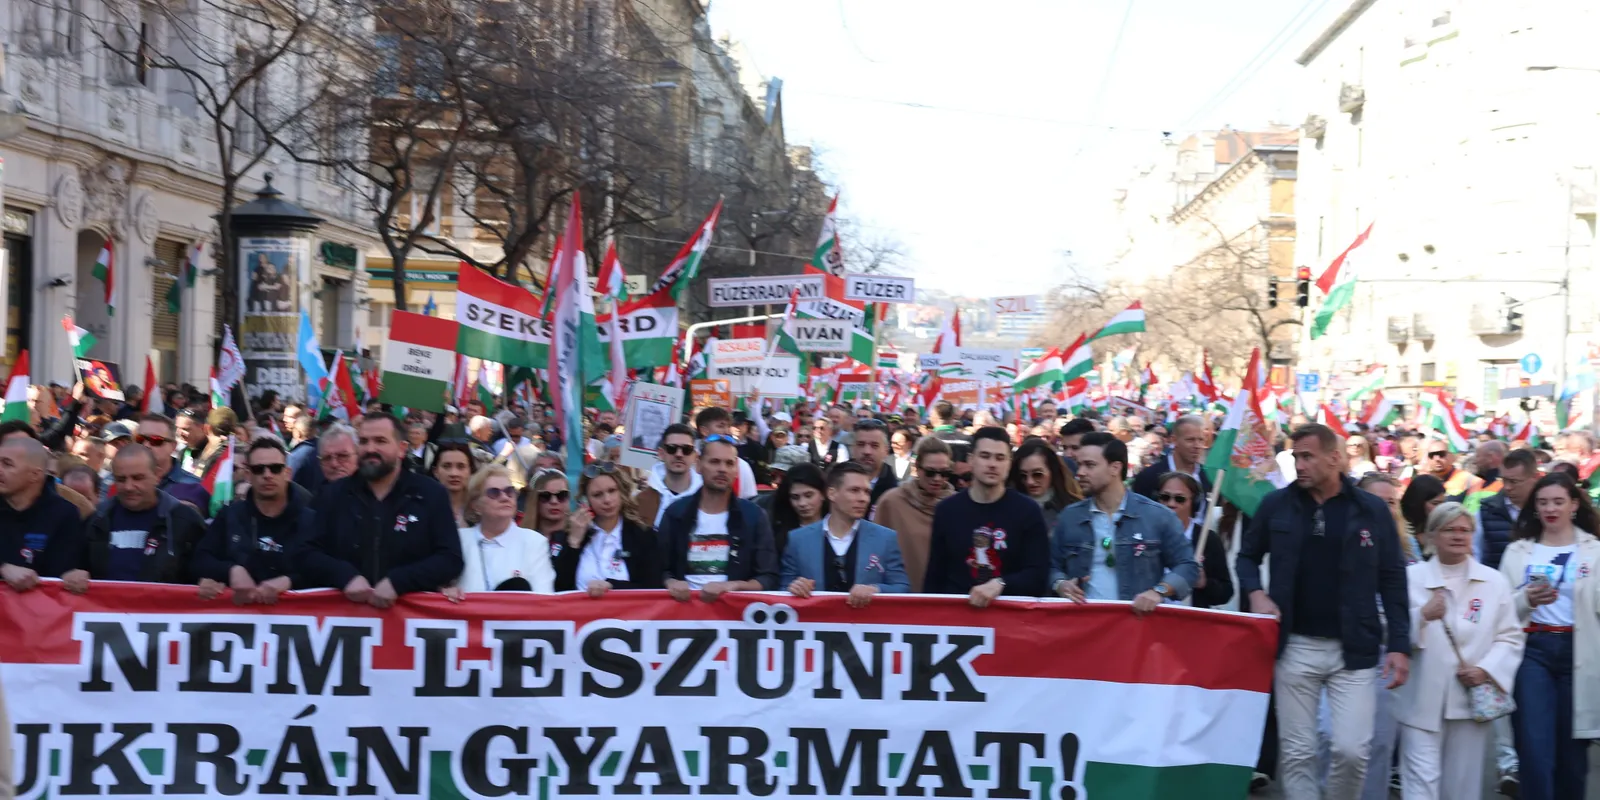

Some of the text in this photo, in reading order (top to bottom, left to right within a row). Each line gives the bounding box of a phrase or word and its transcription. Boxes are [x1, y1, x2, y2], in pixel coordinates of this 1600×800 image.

[796, 324, 844, 341] IVÁN
[80, 609, 987, 703] NEM LESZÜNK
[461, 725, 1080, 800] GYARMAT!
